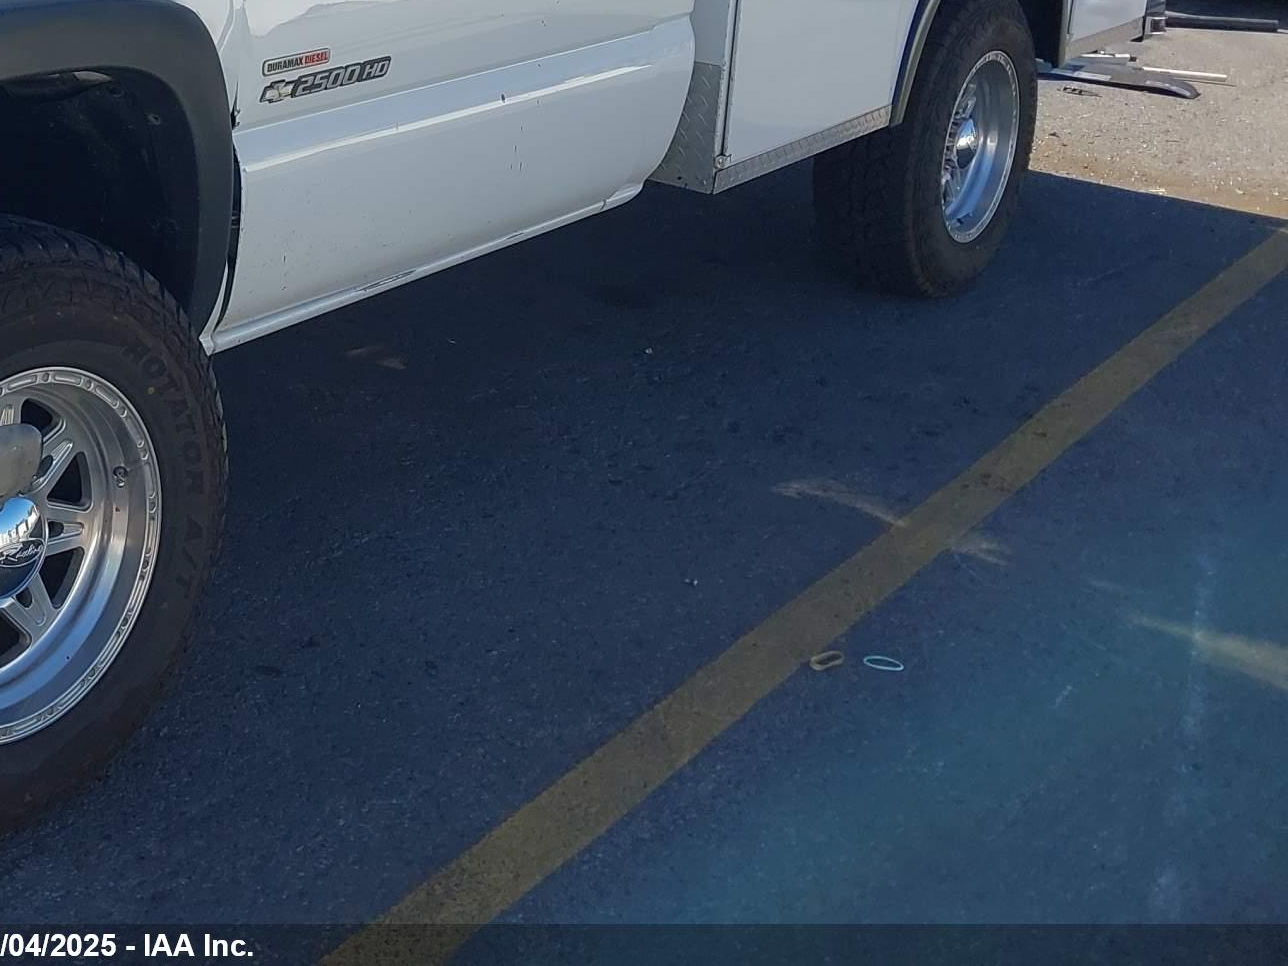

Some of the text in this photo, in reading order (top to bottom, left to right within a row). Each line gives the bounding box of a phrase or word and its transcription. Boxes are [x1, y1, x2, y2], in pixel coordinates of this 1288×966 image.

[266, 51, 329, 73] DURAMAX DIESEL
[296, 61, 390, 95] 2500 HD
